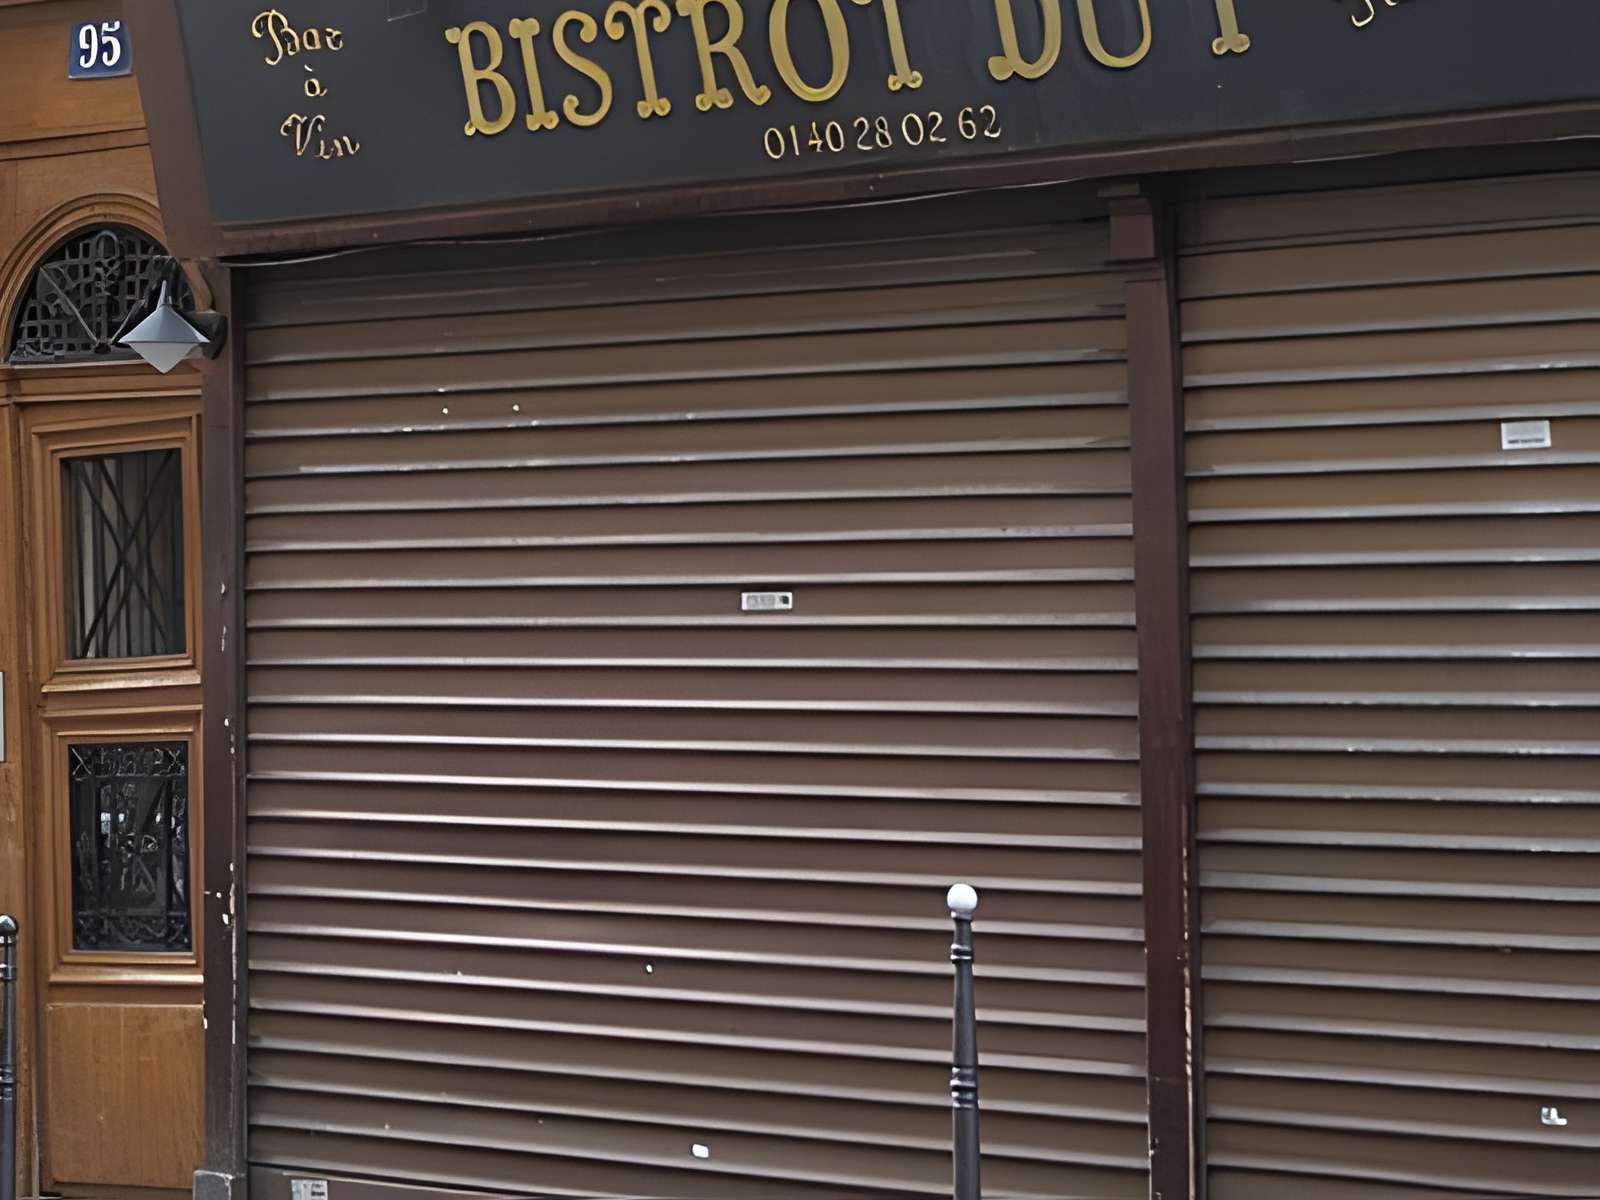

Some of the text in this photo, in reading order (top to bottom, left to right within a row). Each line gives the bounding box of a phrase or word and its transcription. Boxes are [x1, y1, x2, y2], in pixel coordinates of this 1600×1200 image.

[78, 20, 121, 69] 95
[250, 8, 344, 66] Bar
[279, 112, 361, 160] Vin
[763, 124, 800, 159] 01
[853, 115, 893, 150] 28
[901, 110, 947, 146] 02
[958, 104, 1002, 139] 62
